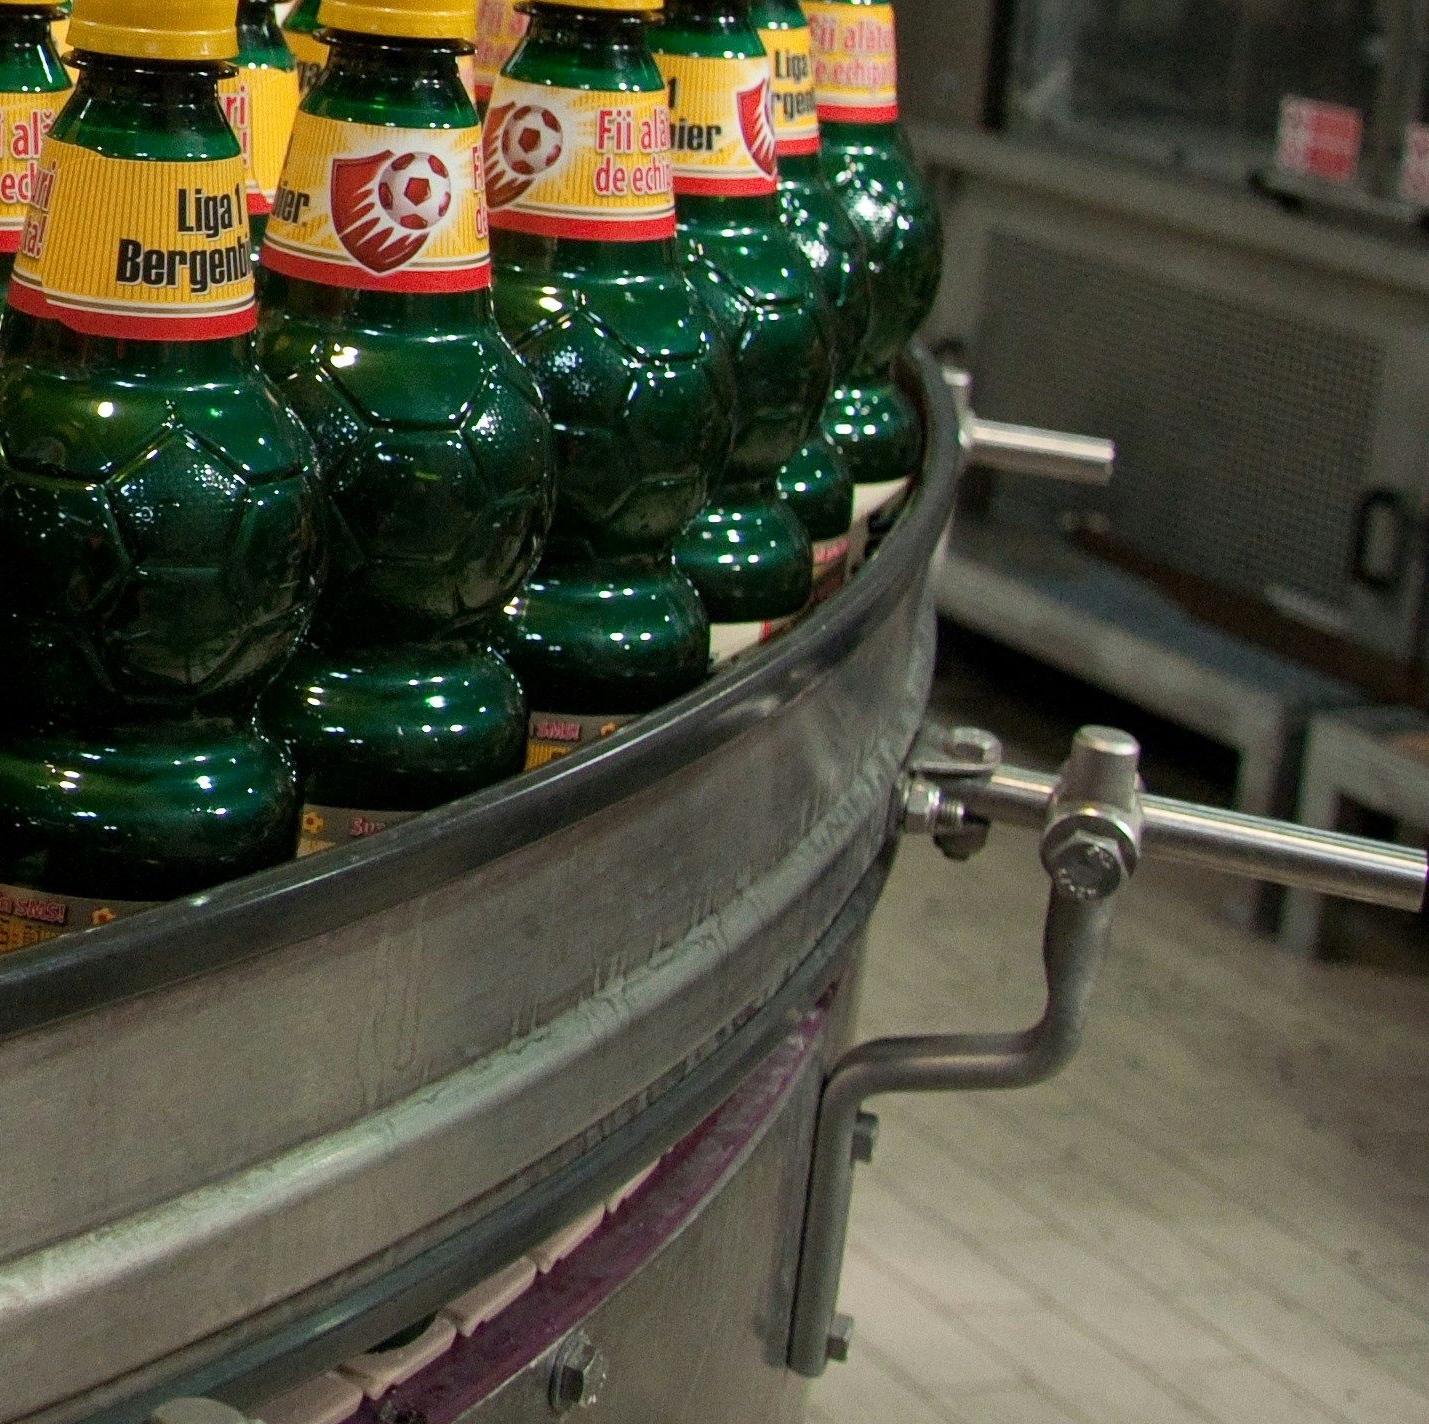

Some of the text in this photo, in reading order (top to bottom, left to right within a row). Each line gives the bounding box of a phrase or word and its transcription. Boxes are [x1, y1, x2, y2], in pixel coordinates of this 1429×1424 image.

[596, 108, 633, 154] Fii
[594, 156, 627, 196] de
[177, 187, 232, 240] Liga
